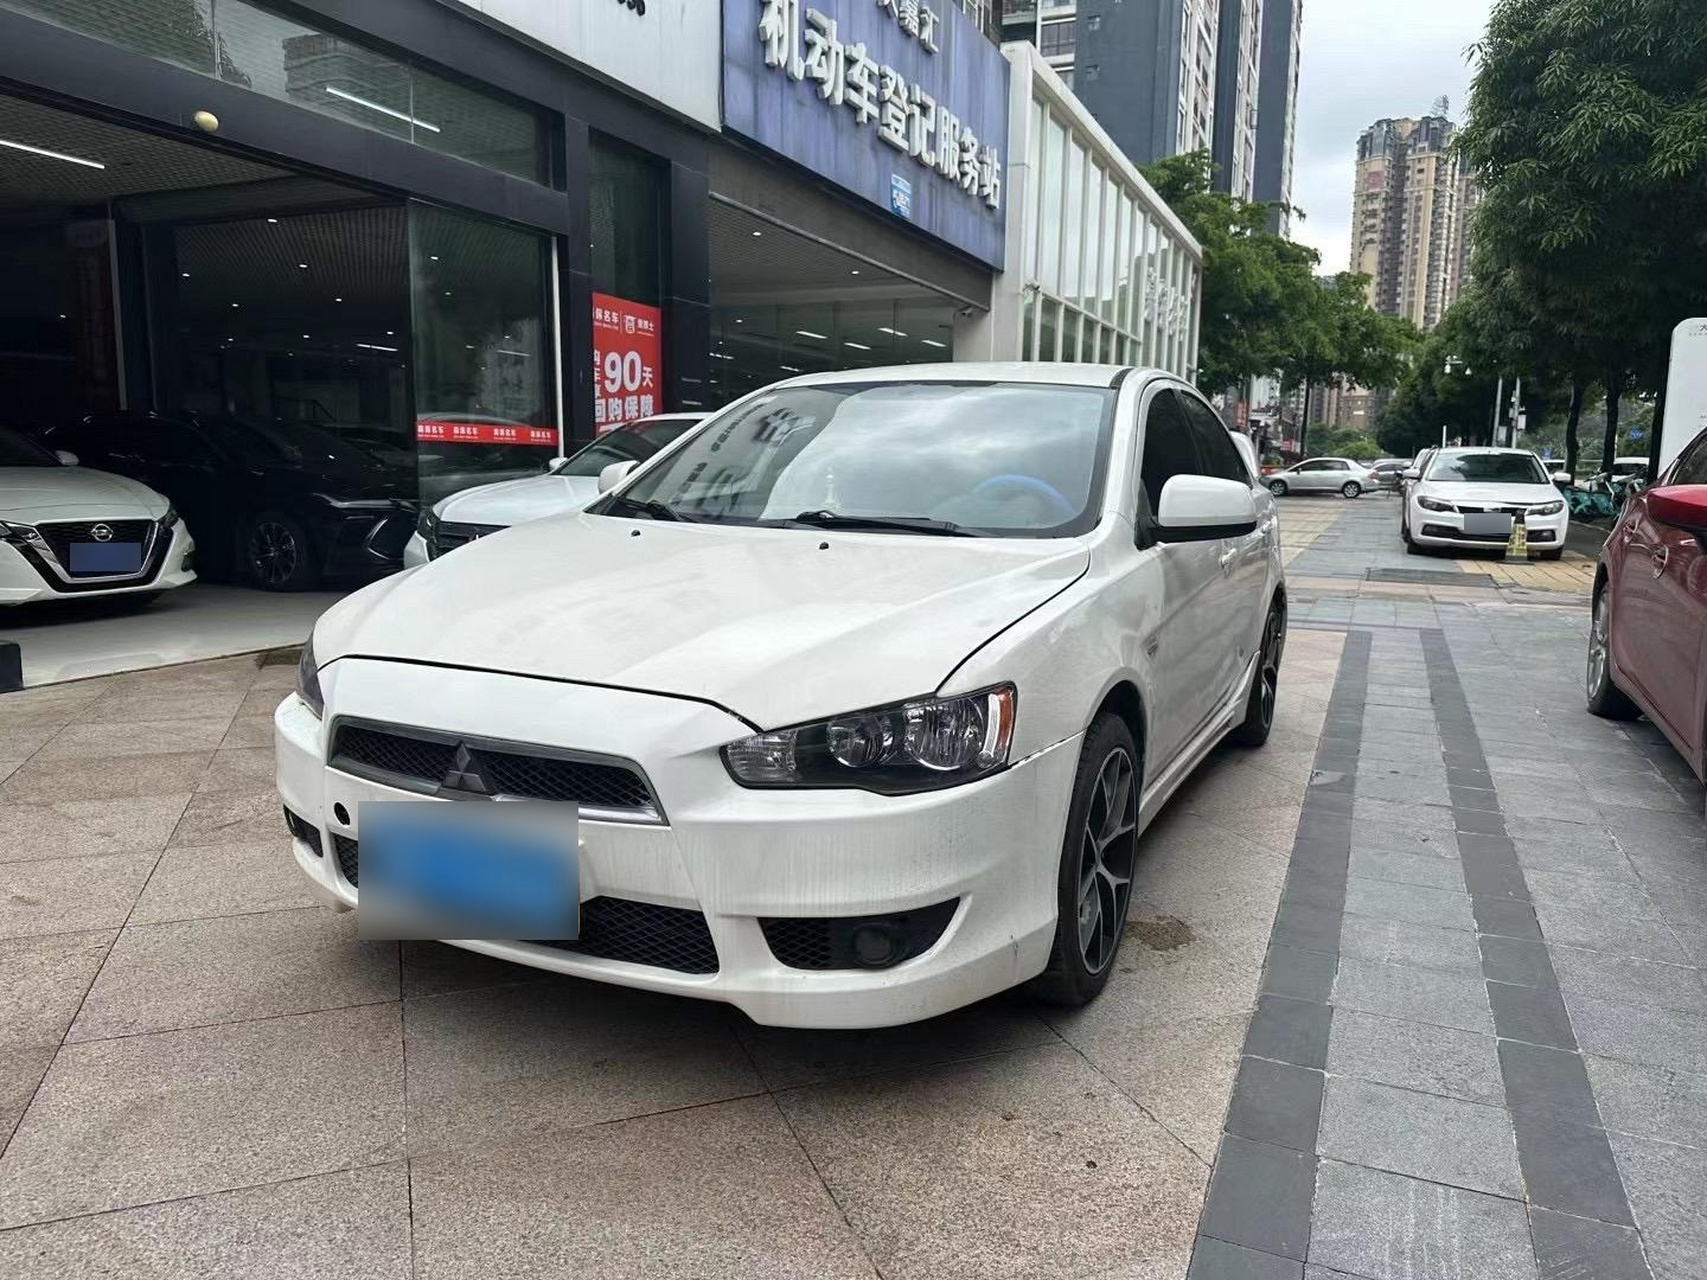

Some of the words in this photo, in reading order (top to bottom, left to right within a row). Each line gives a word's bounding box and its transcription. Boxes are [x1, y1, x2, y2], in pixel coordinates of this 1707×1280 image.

[758, 0, 1000, 209] 机动车登记服务站
[594, 394, 654, 422] 回购保障
